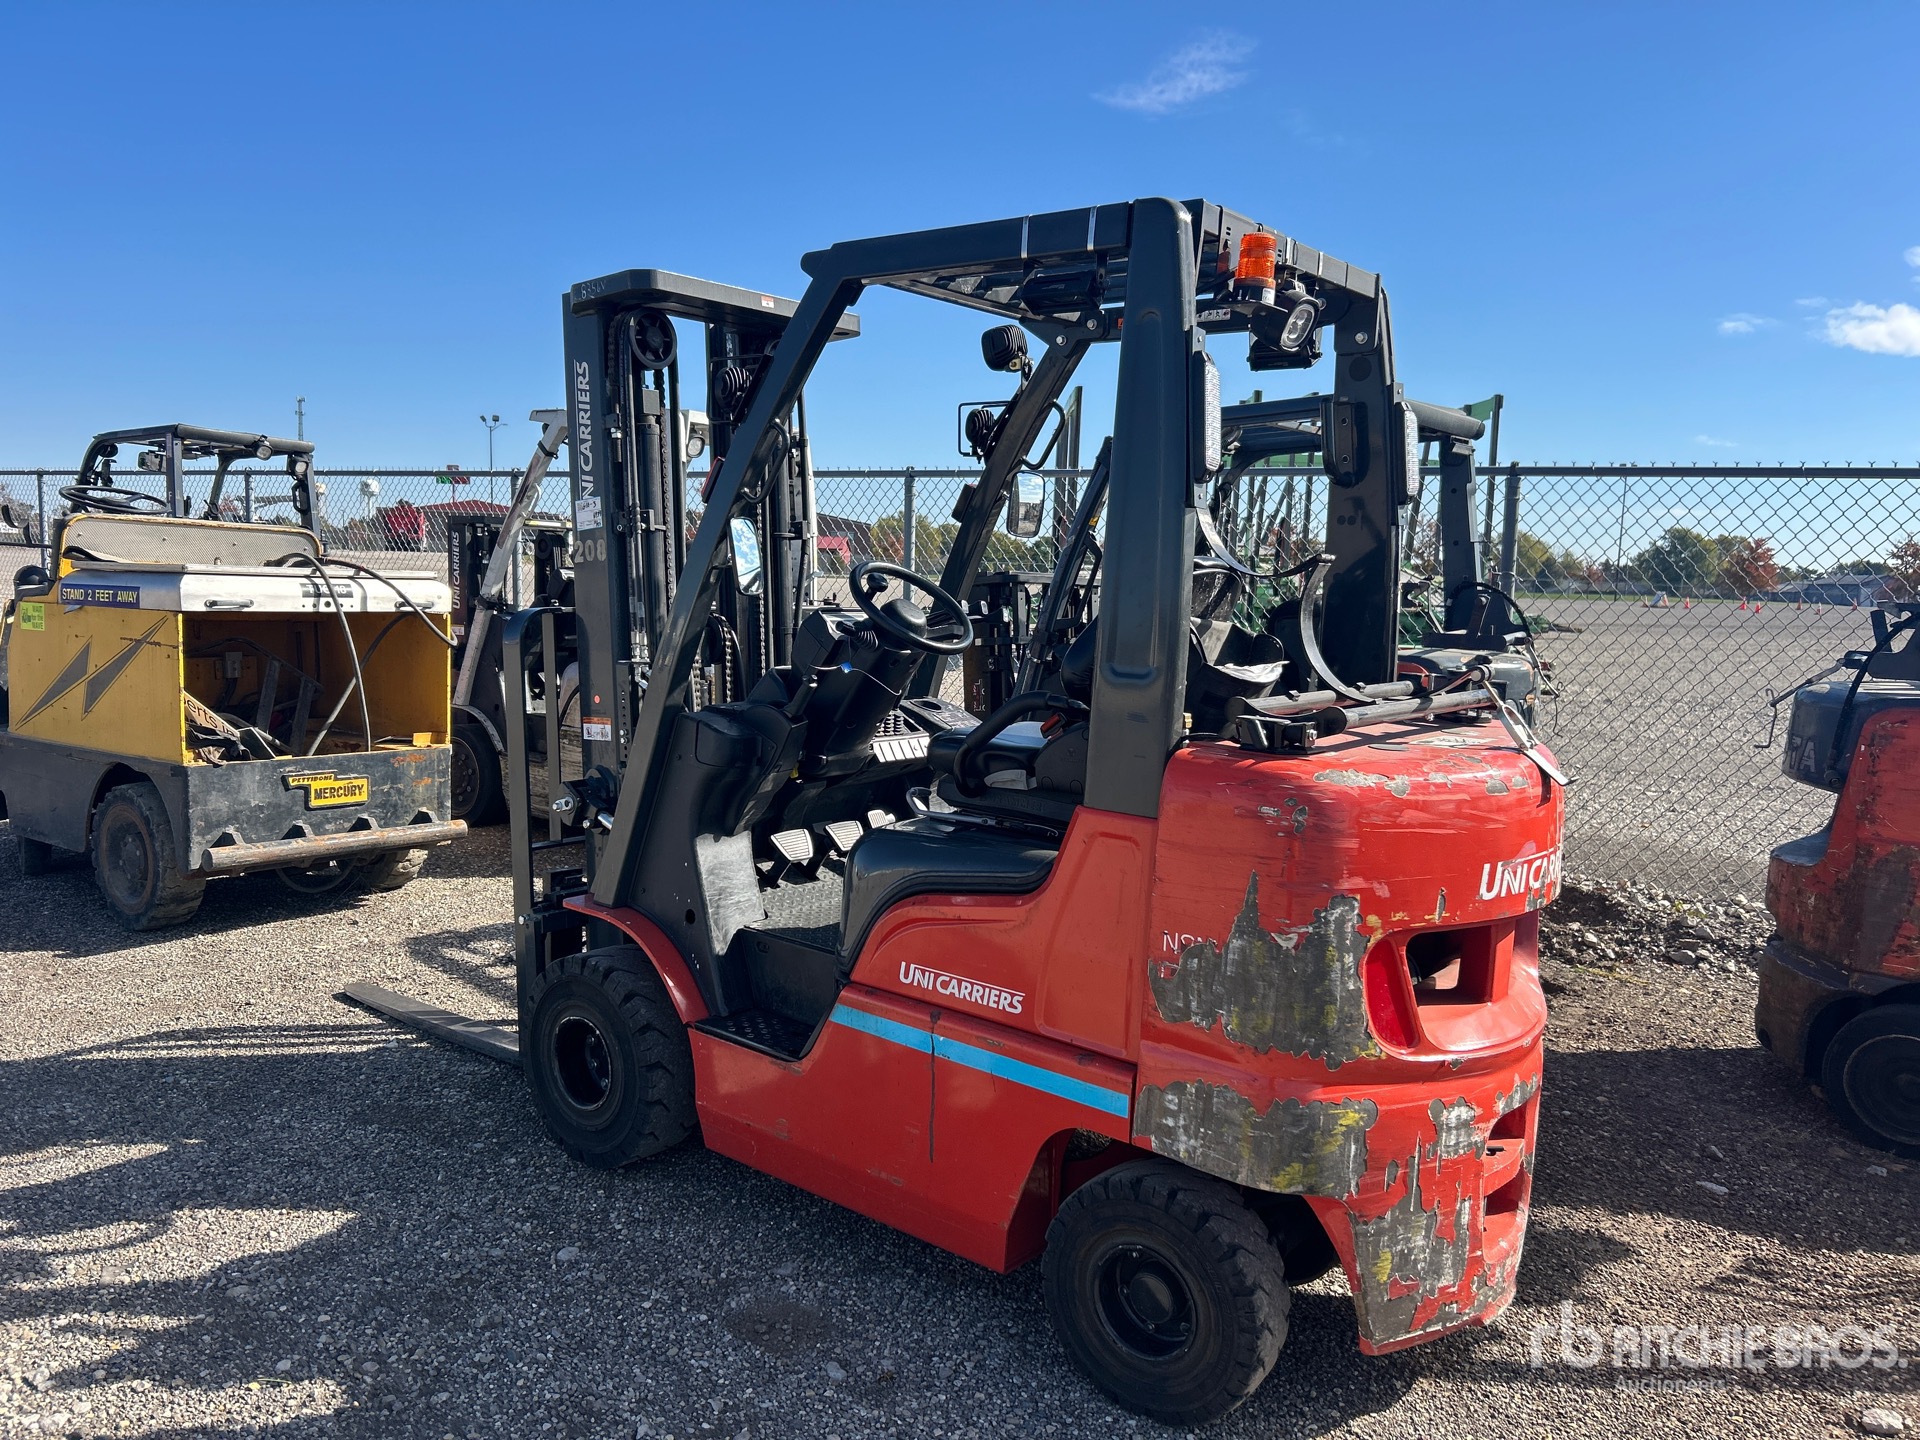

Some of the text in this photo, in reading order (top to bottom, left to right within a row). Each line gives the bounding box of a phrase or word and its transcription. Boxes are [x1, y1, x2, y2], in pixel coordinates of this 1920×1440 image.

[575, 360, 595, 500] NICARRIERS
[574, 539, 607, 563] 208
[451, 531, 461, 609] UNICARRIERS
[62, 588, 138, 603] STAND 2 FEET AWAY
[184, 698, 218, 729] erts
[291, 774, 333, 784] PETTIBONE
[313, 783, 365, 801] MERCURY
[898, 961, 1026, 1014] UNICARRIERS
